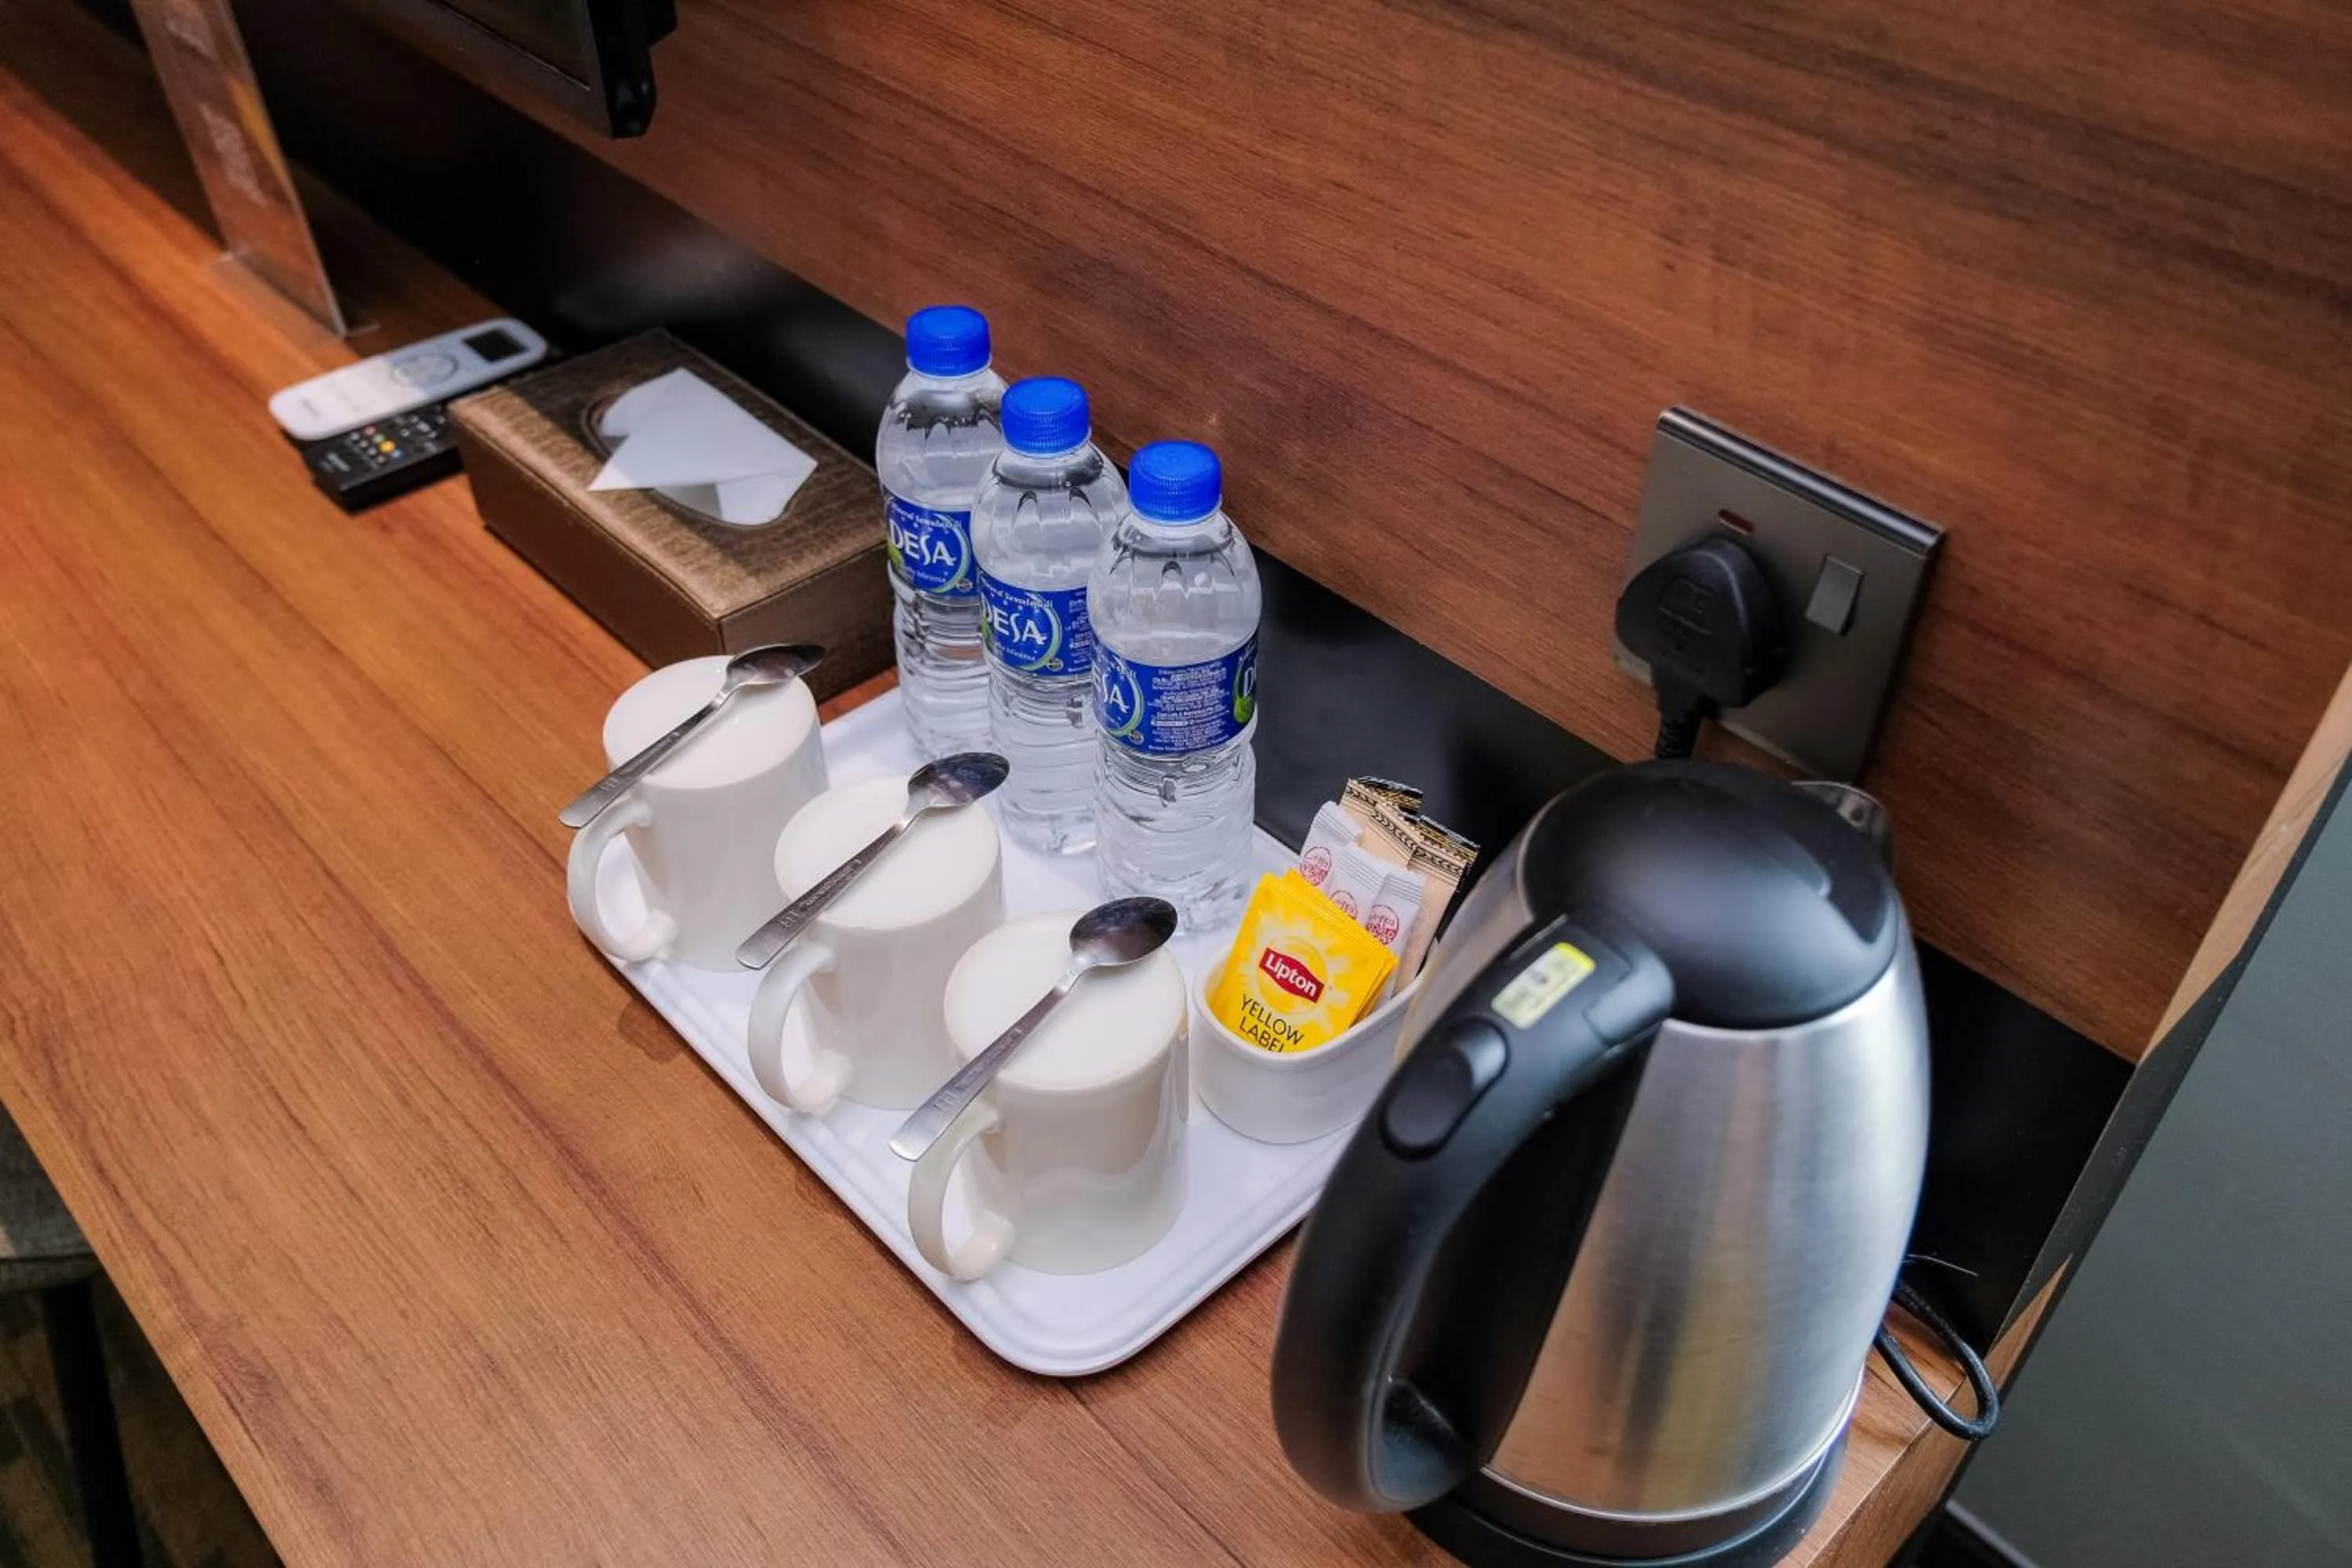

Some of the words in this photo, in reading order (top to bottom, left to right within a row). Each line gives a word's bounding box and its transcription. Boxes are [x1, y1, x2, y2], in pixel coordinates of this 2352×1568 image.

[888, 517, 956, 567] DESA
[1092, 660, 1129, 714] ESA
[1265, 953, 1317, 997] Lipton
[1241, 993, 1305, 1045] YELLOW
